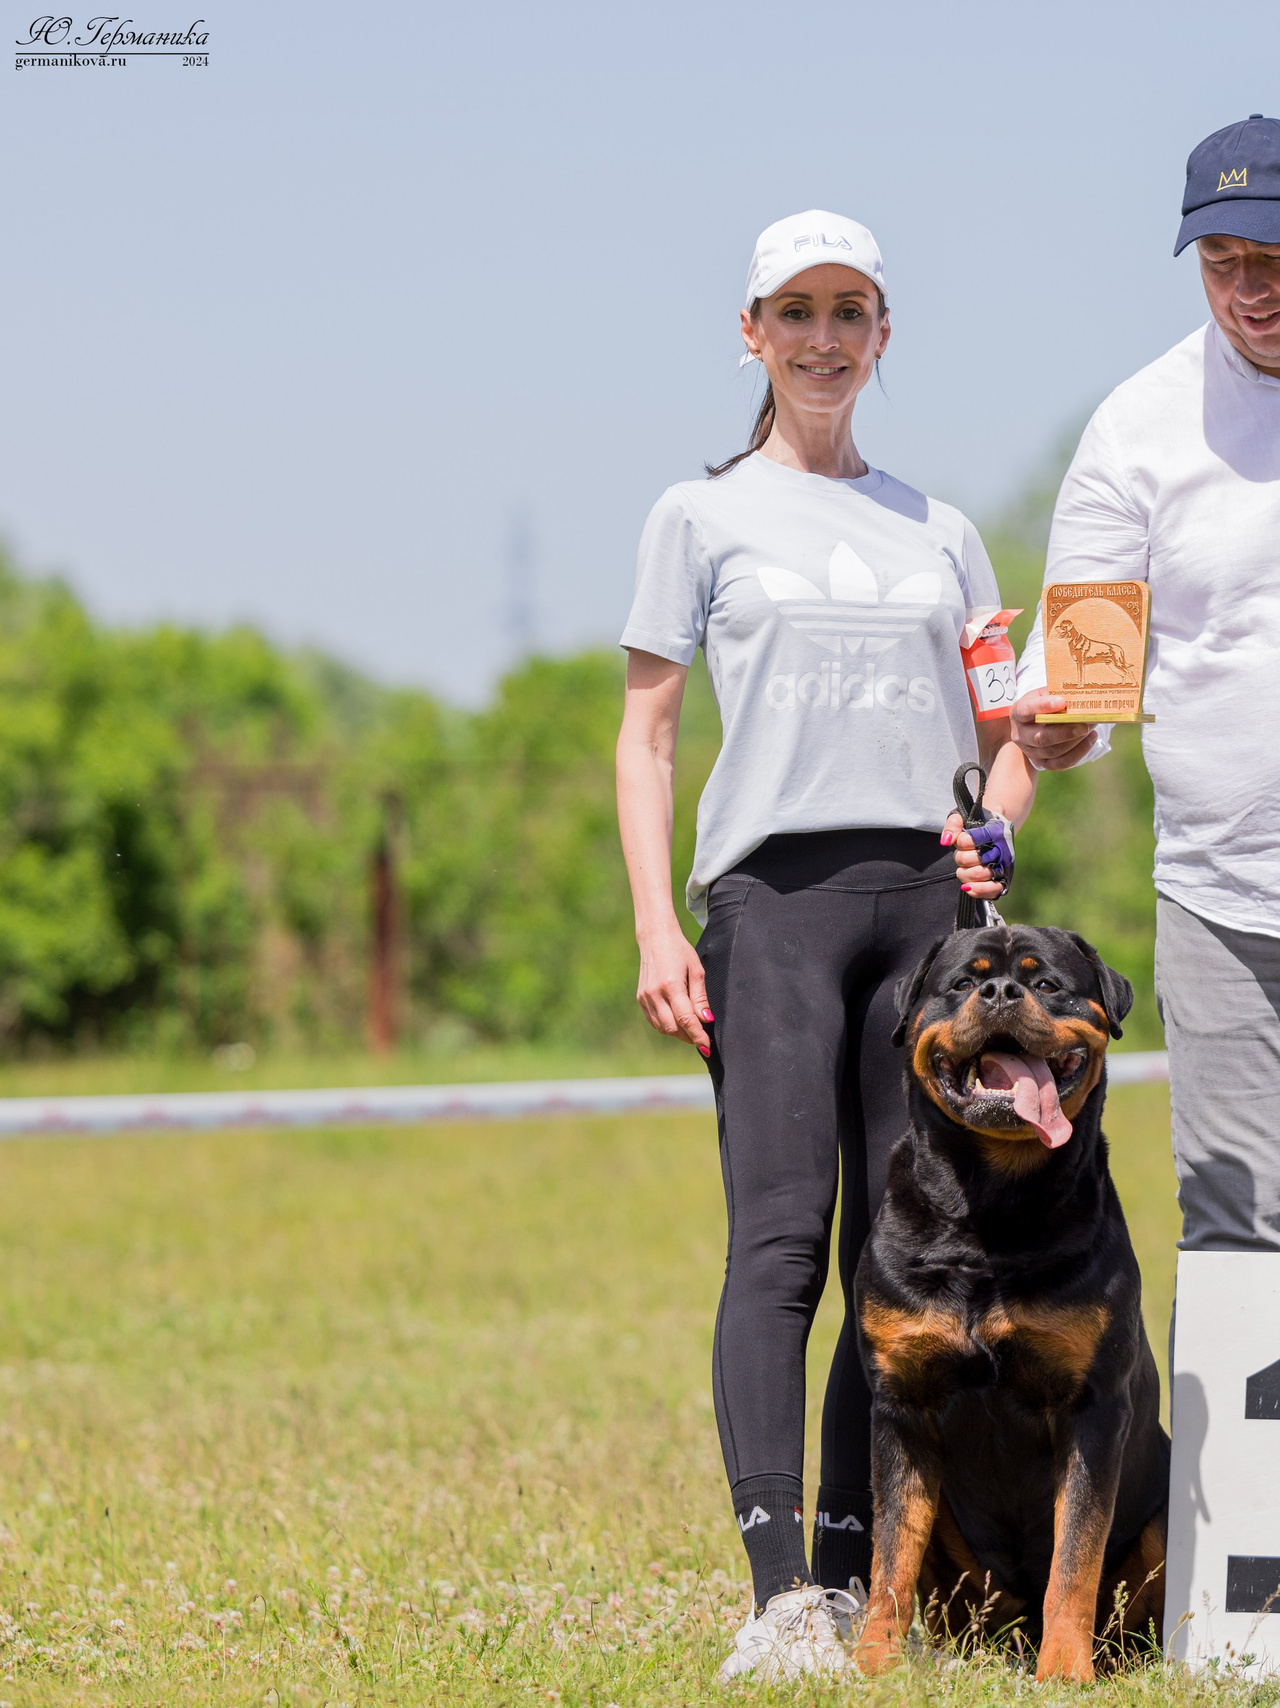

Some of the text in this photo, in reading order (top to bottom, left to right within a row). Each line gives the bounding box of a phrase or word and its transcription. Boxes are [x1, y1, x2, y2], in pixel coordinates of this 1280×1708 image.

[793, 233, 852, 252] FILA
[1106, 585, 1137, 597] КЛАССА
[765, 661, 935, 712] adidas
[815, 1510, 865, 1532] ILA
